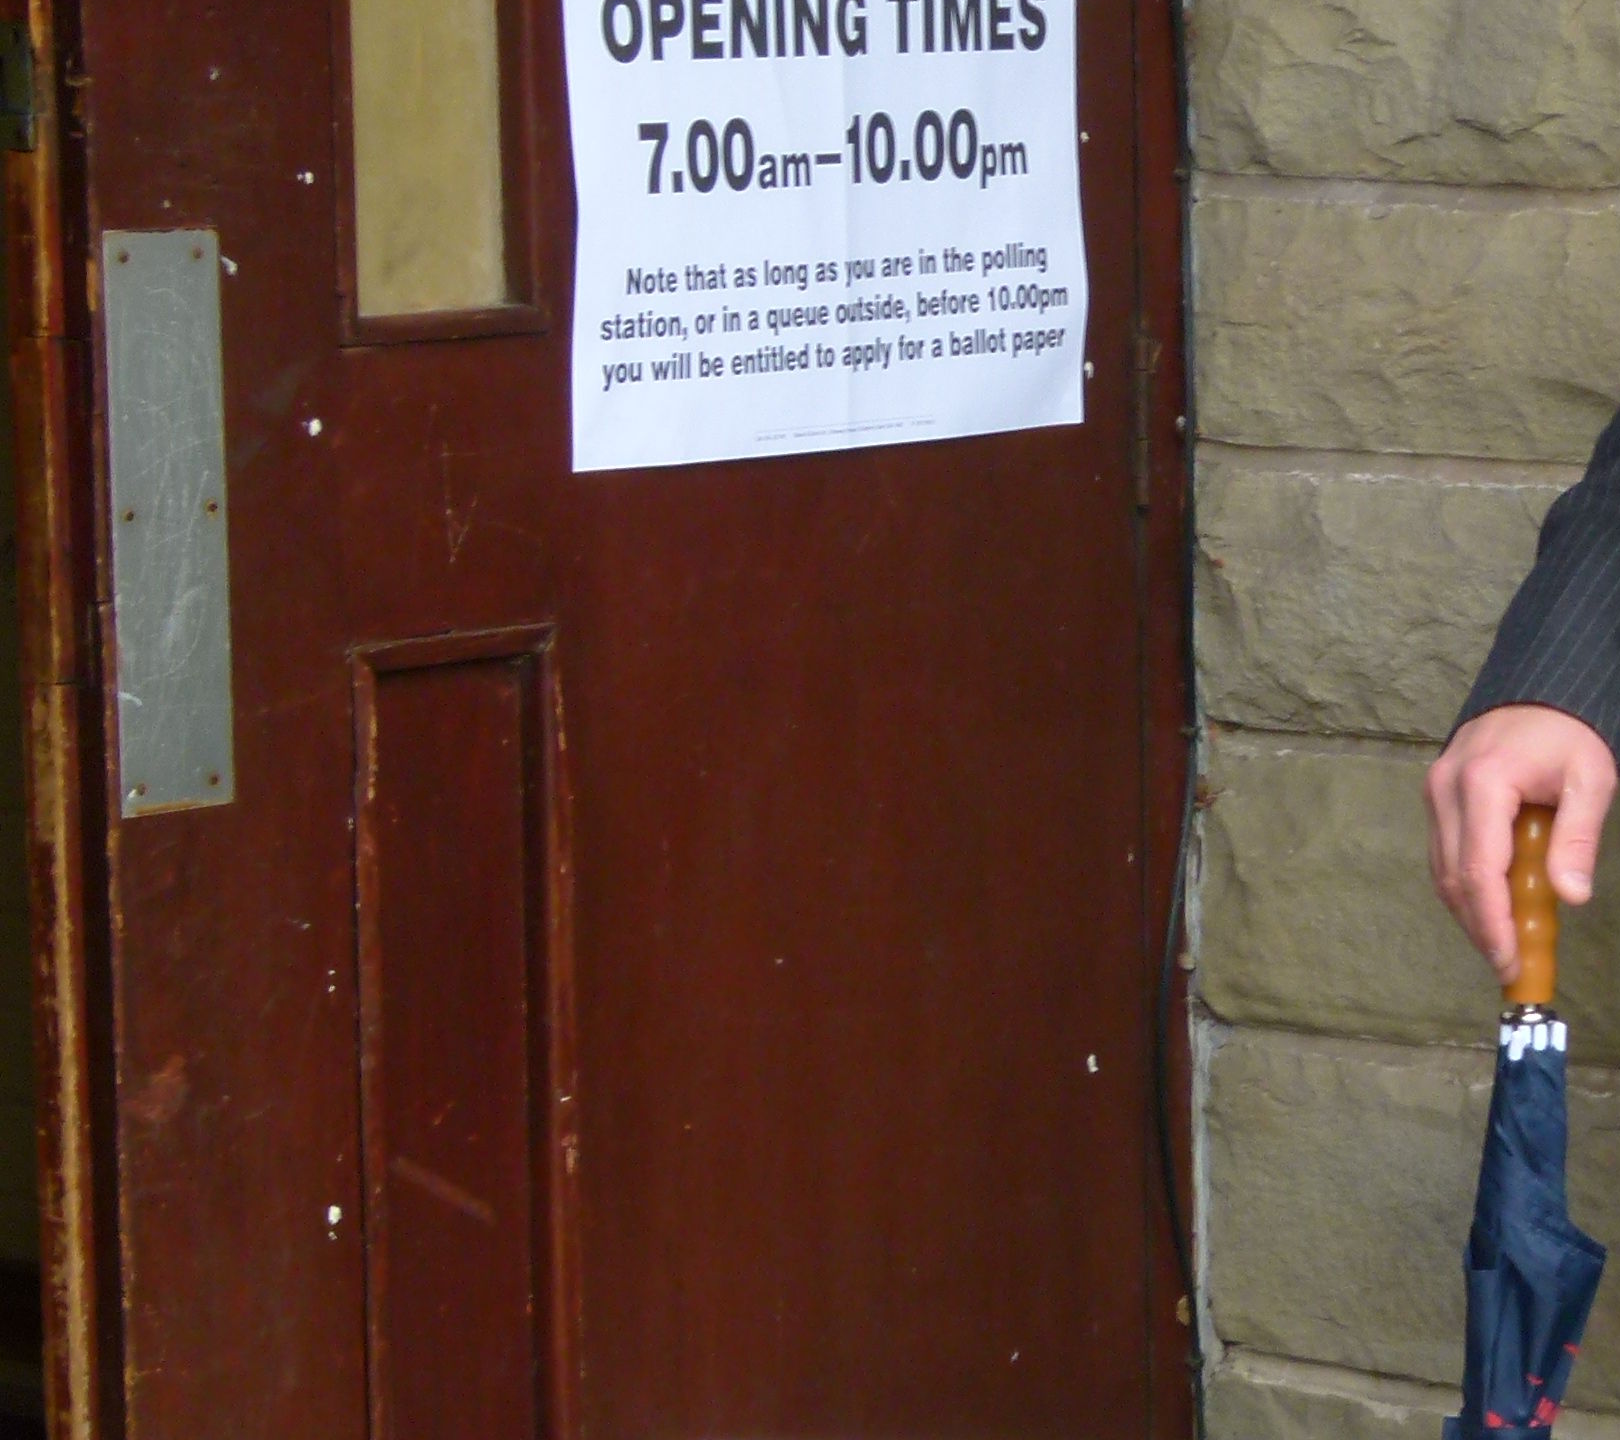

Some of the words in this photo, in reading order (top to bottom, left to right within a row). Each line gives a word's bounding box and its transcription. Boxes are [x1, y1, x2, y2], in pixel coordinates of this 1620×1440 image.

[626, 267, 678, 295] Note
[685, 263, 727, 291] that
[733, 266, 757, 288] as
[763, 259, 809, 291] long
[815, 260, 838, 282] as
[845, 258, 875, 288] you
[881, 255, 912, 278] are
[918, 248, 937, 274] in
[943, 246, 975, 273] the
[982, 242, 1048, 277] polling
[600, 310, 688, 341] station,
[694, 313, 716, 335] or
[722, 305, 741, 332] in
[748, 309, 759, 330] a
[766, 304, 829, 336] queue
[835, 293, 912, 324] outside,
[916, 289, 980, 317] before
[987, 283, 1068, 314] 10.00pm
[602, 360, 642, 392] you
[651, 352, 691, 381] will
[698, 351, 724, 378] be
[731, 343, 810, 376] entitled
[816, 343, 835, 368] to
[841, 336, 892, 373] apply
[898, 334, 925, 360] for
[931, 337, 943, 358] a
[949, 328, 1006, 356] ballot
[1012, 327, 1066, 358] paper
